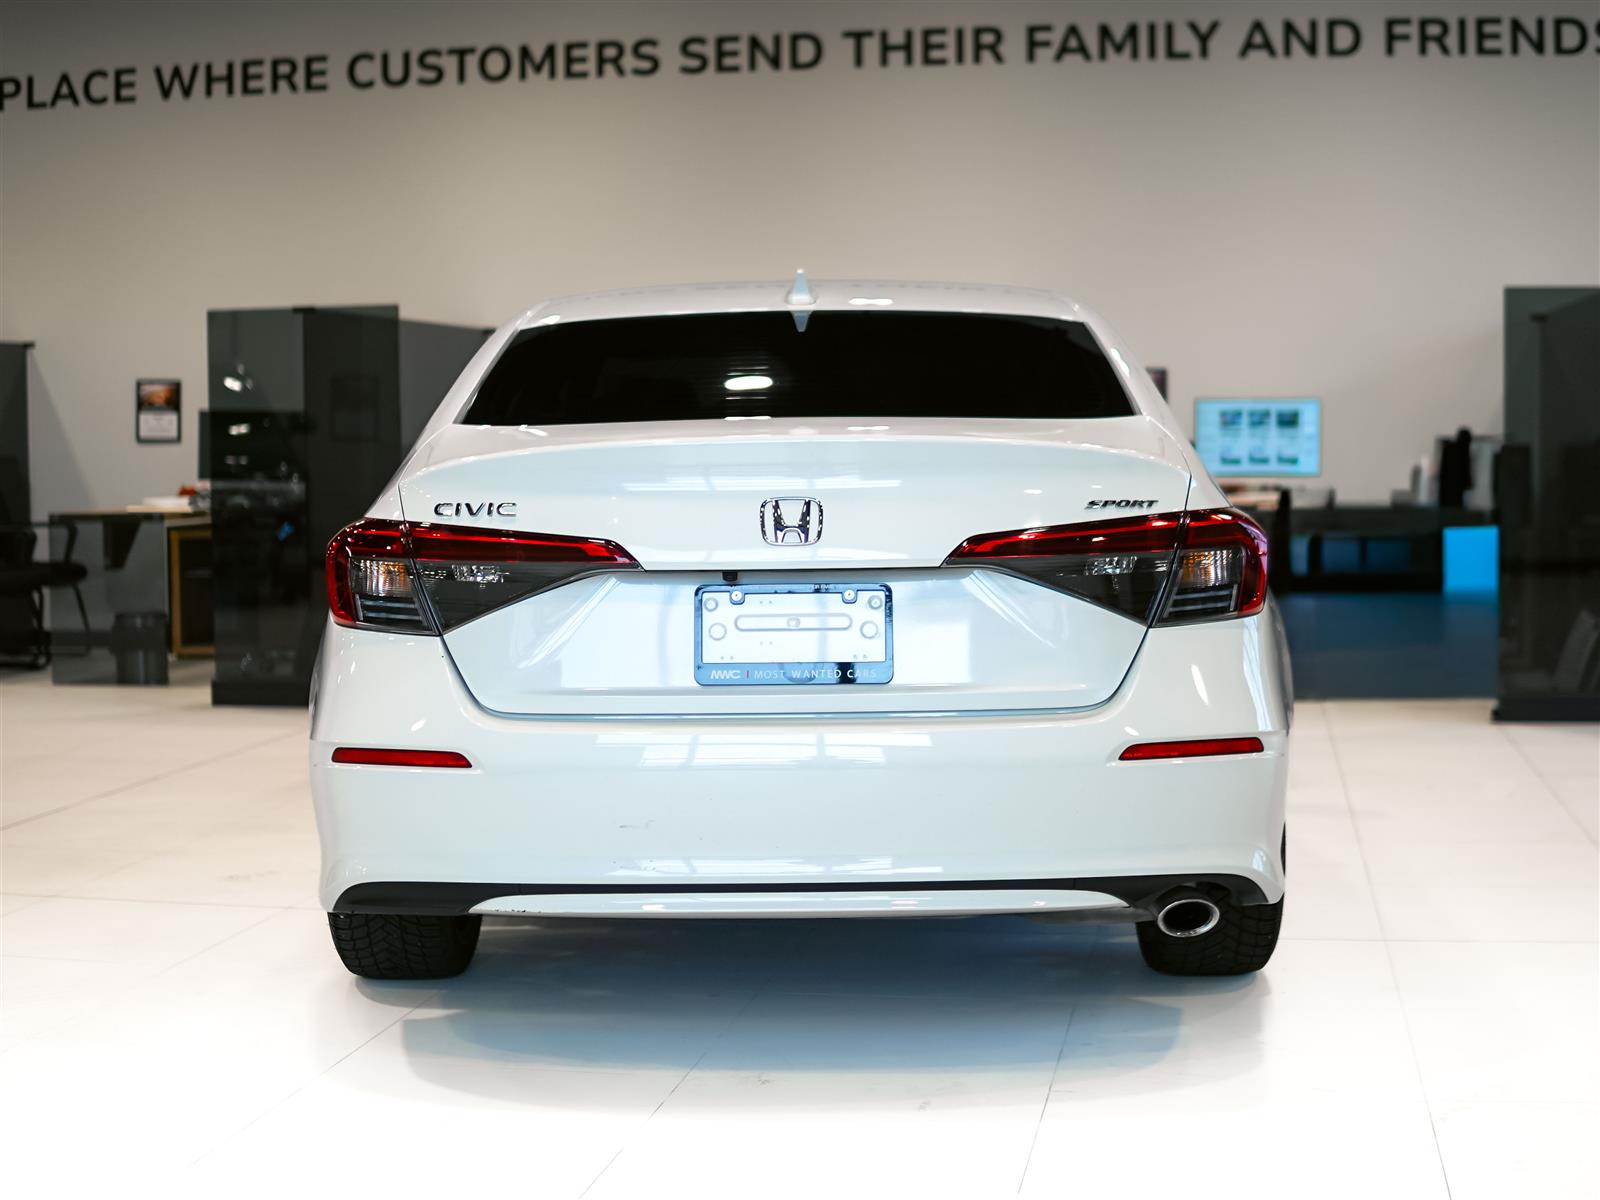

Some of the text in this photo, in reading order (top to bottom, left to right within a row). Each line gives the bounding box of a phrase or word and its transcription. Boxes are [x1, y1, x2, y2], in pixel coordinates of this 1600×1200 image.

[0, 15, 1600, 113] PLACE WHERE CUSTOMERS SEND THEIR FAMILY AND FRIEND
[433, 502, 517, 516] CIVIC
[1085, 499, 1159, 510] SPORT
[754, 670, 784, 679] MOST
[791, 669, 842, 679] WANTED
[846, 669, 877, 678] CARS
